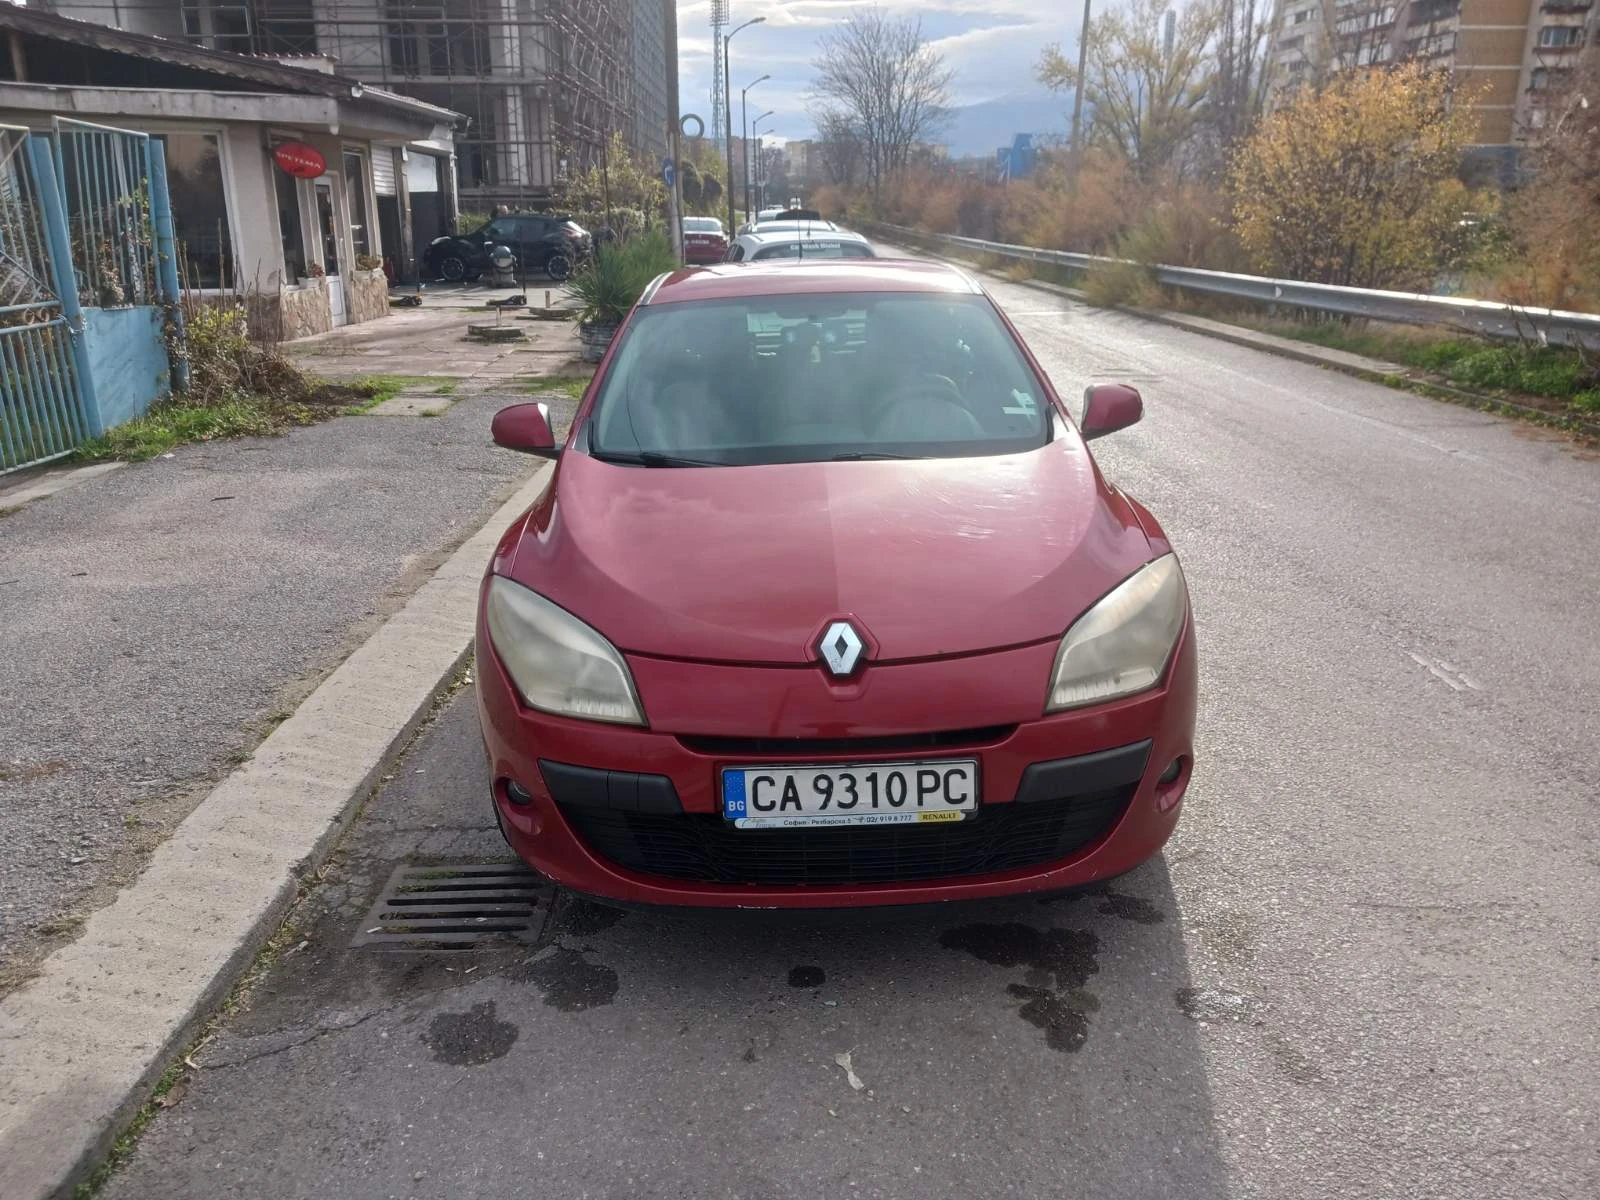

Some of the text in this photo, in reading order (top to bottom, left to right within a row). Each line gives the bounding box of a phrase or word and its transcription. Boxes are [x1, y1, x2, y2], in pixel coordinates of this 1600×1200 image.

[751, 768, 968, 812] CA 9310 PC
[728, 800, 745, 812] BG
[922, 812, 958, 820] RENAULT
